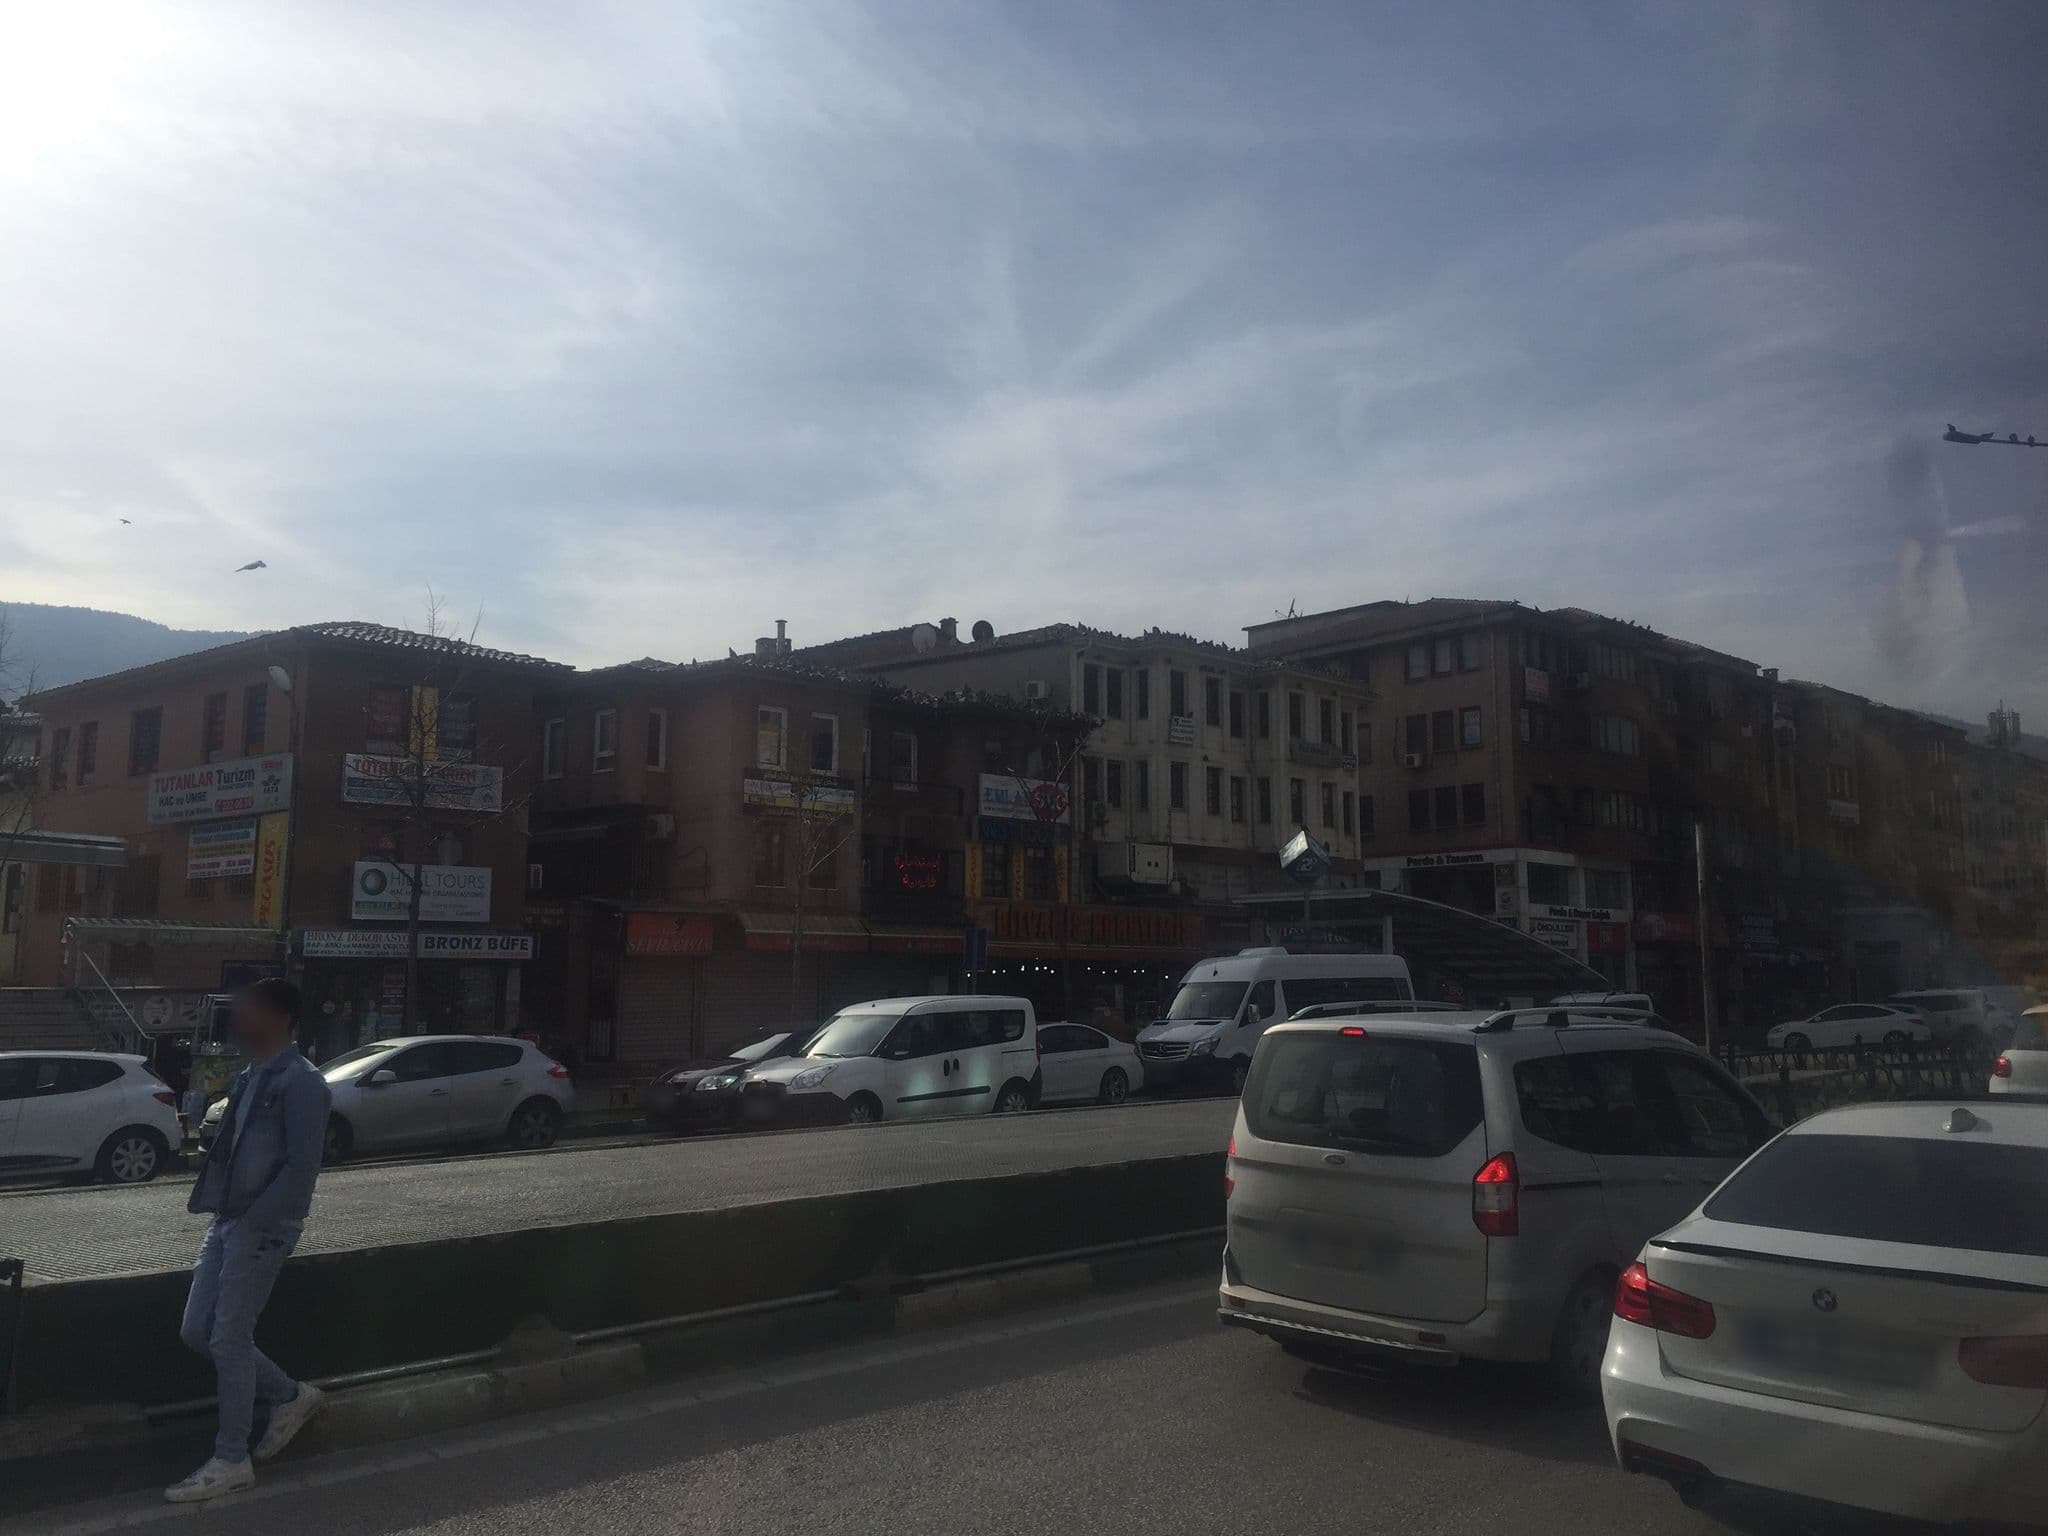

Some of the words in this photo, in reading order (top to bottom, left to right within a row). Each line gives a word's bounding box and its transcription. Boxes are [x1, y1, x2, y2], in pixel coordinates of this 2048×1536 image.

[154, 769, 213, 793] TUTANLAR
[216, 767, 255, 785] Turizm
[436, 872, 486, 890] TOURS
[306, 930, 344, 942] BRONZ
[423, 935, 482, 950] BRONZ
